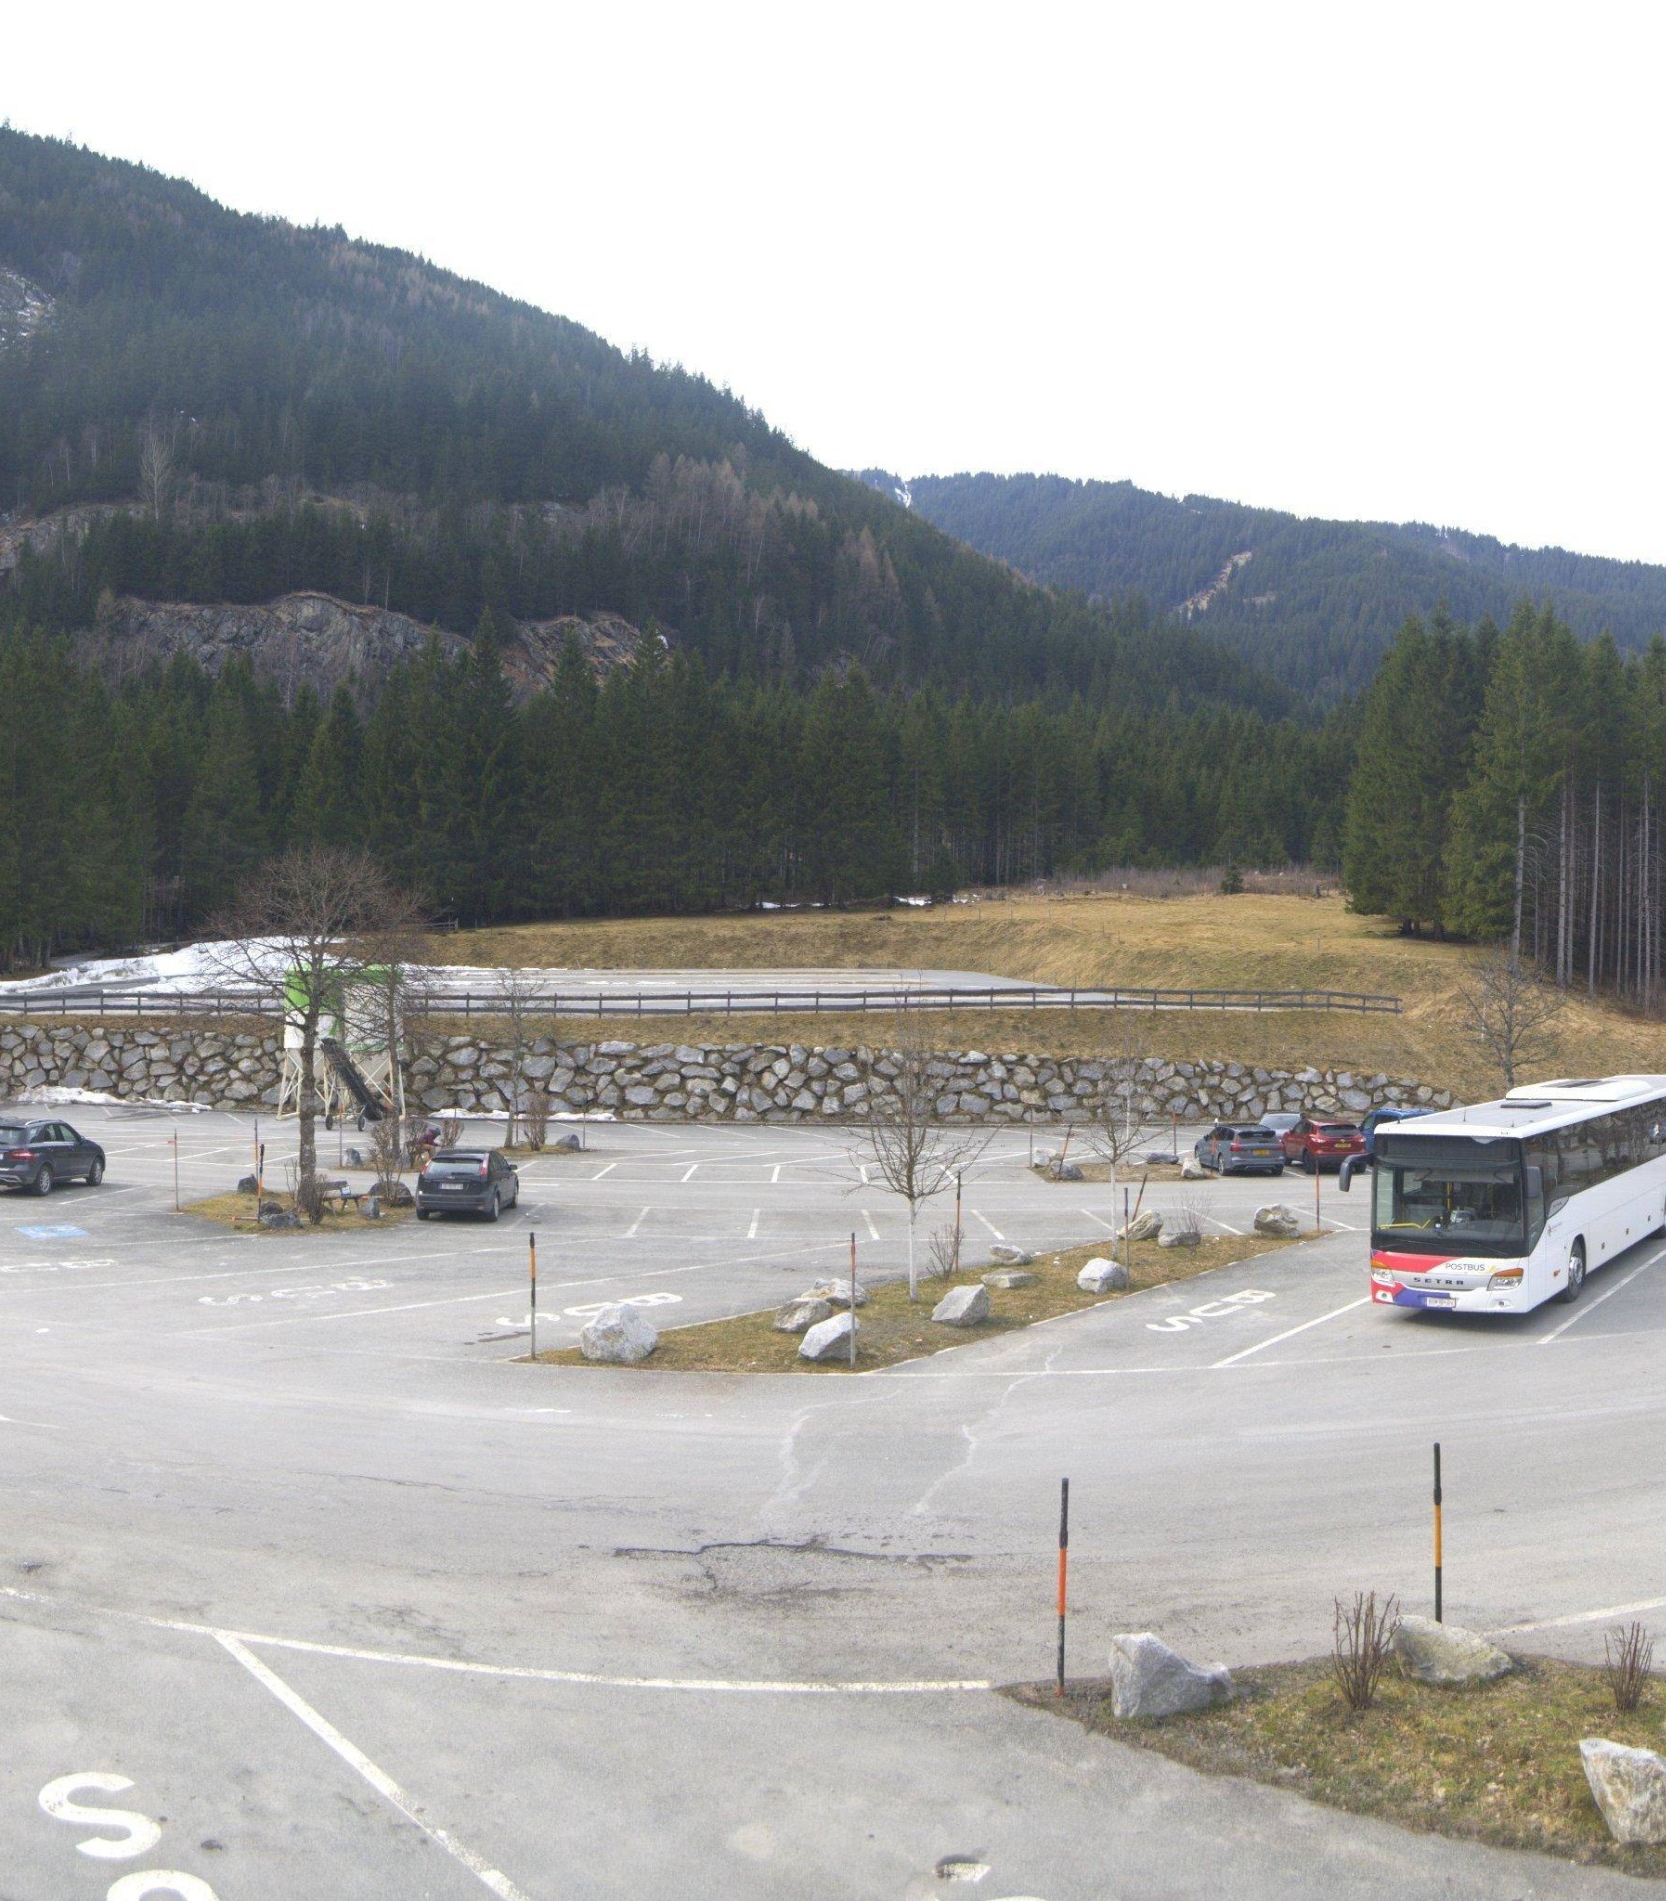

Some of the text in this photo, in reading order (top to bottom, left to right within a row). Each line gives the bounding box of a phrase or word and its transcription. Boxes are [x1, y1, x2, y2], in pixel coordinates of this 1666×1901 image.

[1445, 1263, 1485, 1271] POSTBUS
[1413, 1277, 1464, 1285] SETRA
[1146, 1289, 1276, 1332] BUS
